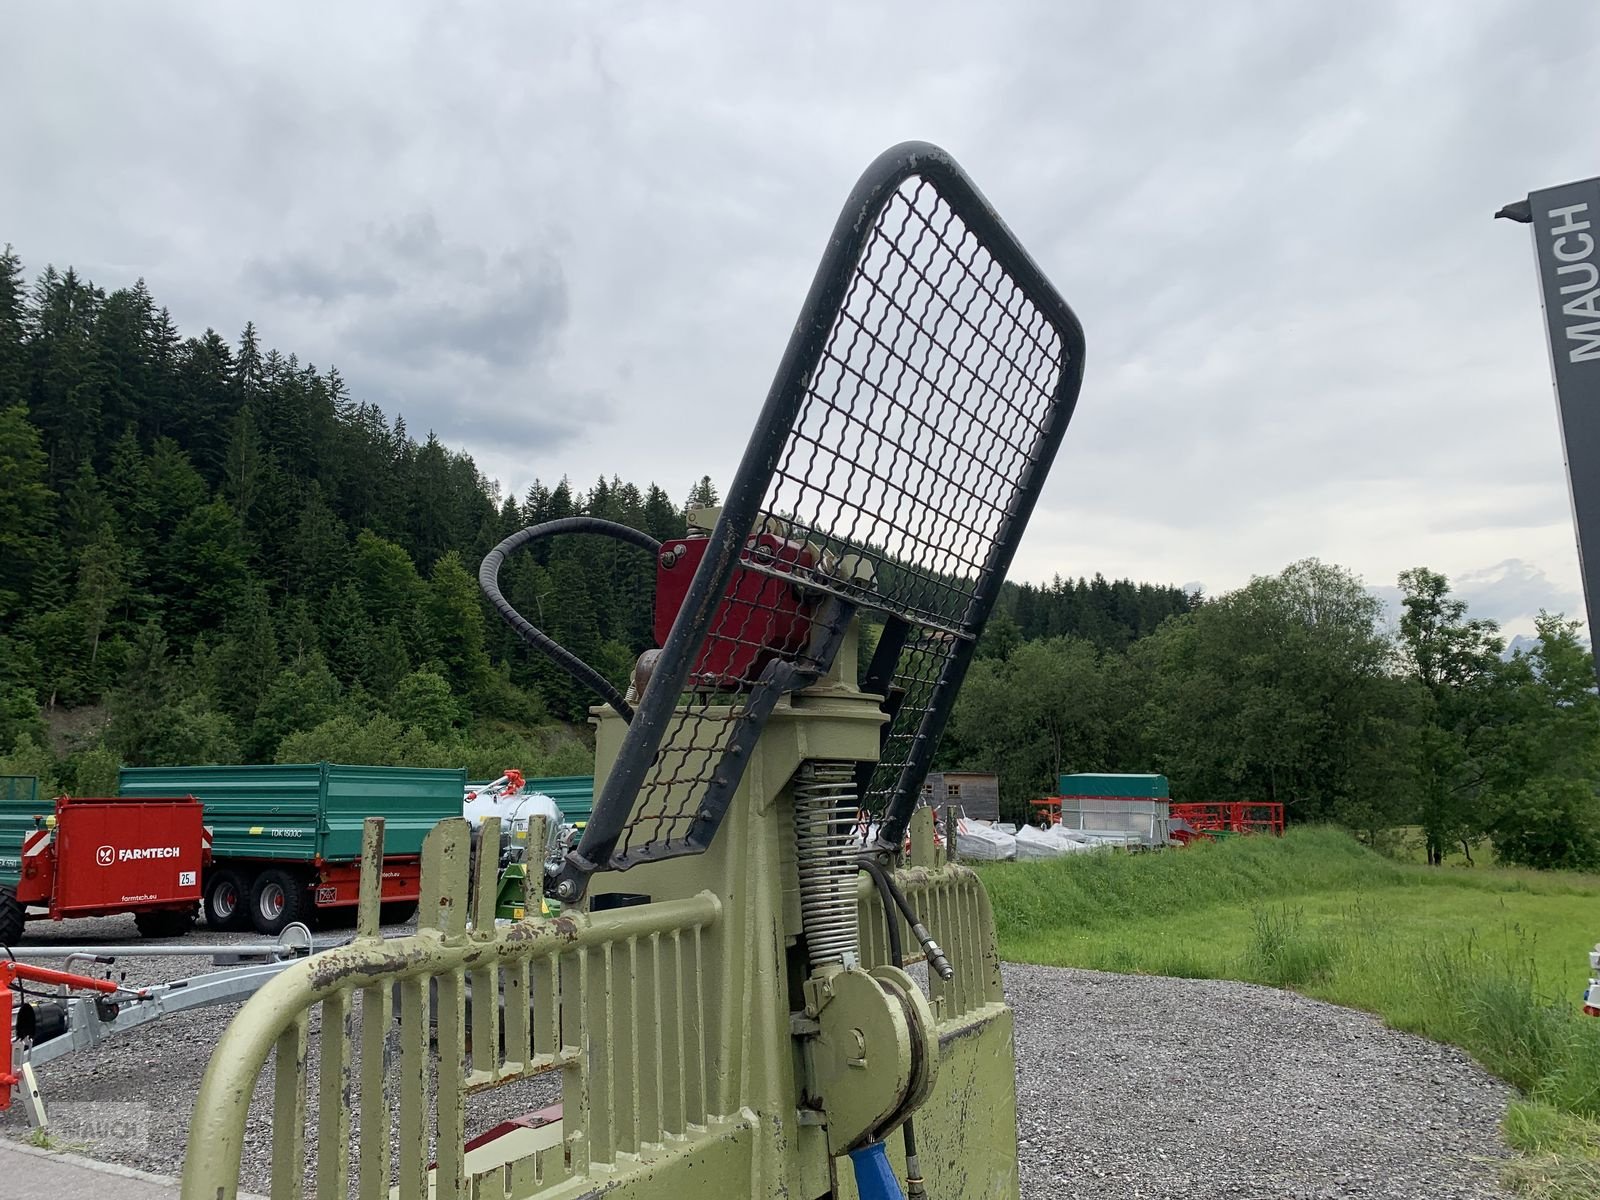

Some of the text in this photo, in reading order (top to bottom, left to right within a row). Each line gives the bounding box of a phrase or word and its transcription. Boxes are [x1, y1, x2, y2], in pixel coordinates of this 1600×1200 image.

[1548, 202, 1600, 363] MAUCH
[118, 847, 180, 862] FARMTECH
[181, 873, 190, 885] 25
[121, 894, 158, 902] farmtech.eu
